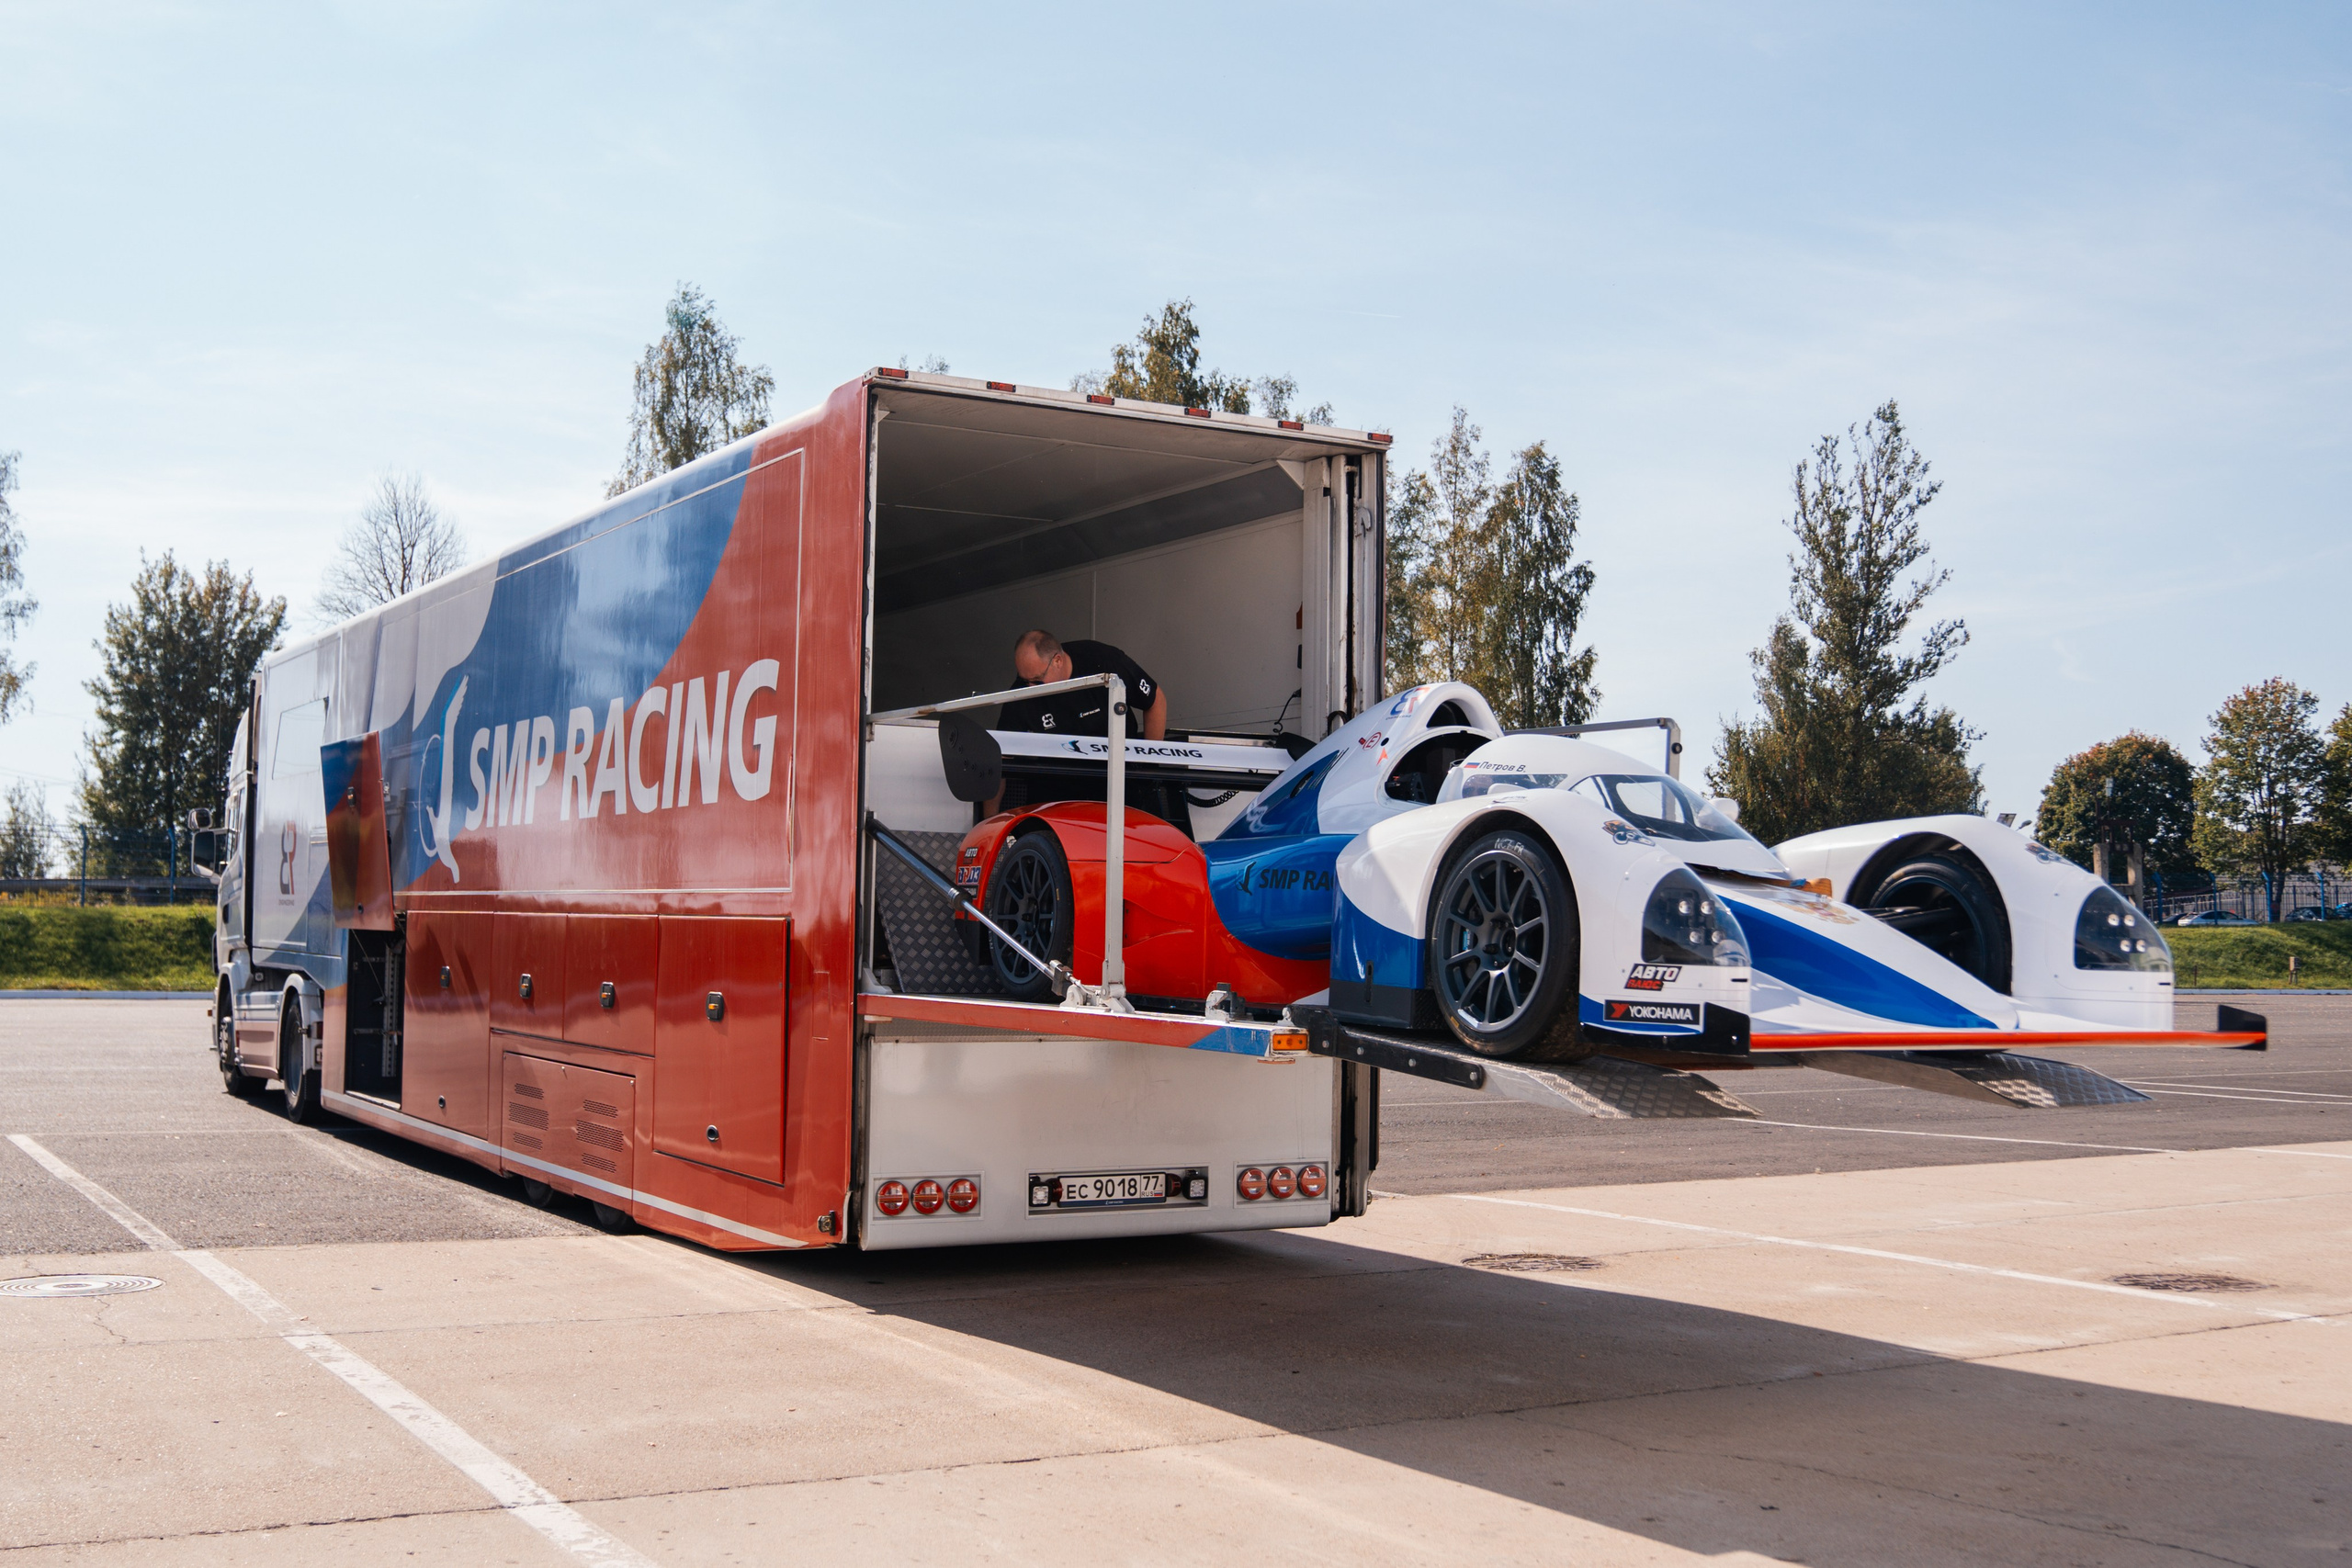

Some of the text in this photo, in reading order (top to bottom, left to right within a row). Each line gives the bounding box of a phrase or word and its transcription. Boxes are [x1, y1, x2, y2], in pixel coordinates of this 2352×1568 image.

[464, 658, 781, 831] SMP RACING
[1134, 746, 1203, 759] RACING
[1479, 761, 1516, 773] Петров
[1259, 869, 1300, 889] SMP
[1630, 964, 1679, 981] АВТО
[1629, 1005, 1693, 1021] YOKOHAMA
[1093, 1178, 1137, 1198] 9018
[1142, 1176, 1159, 1190] 77
